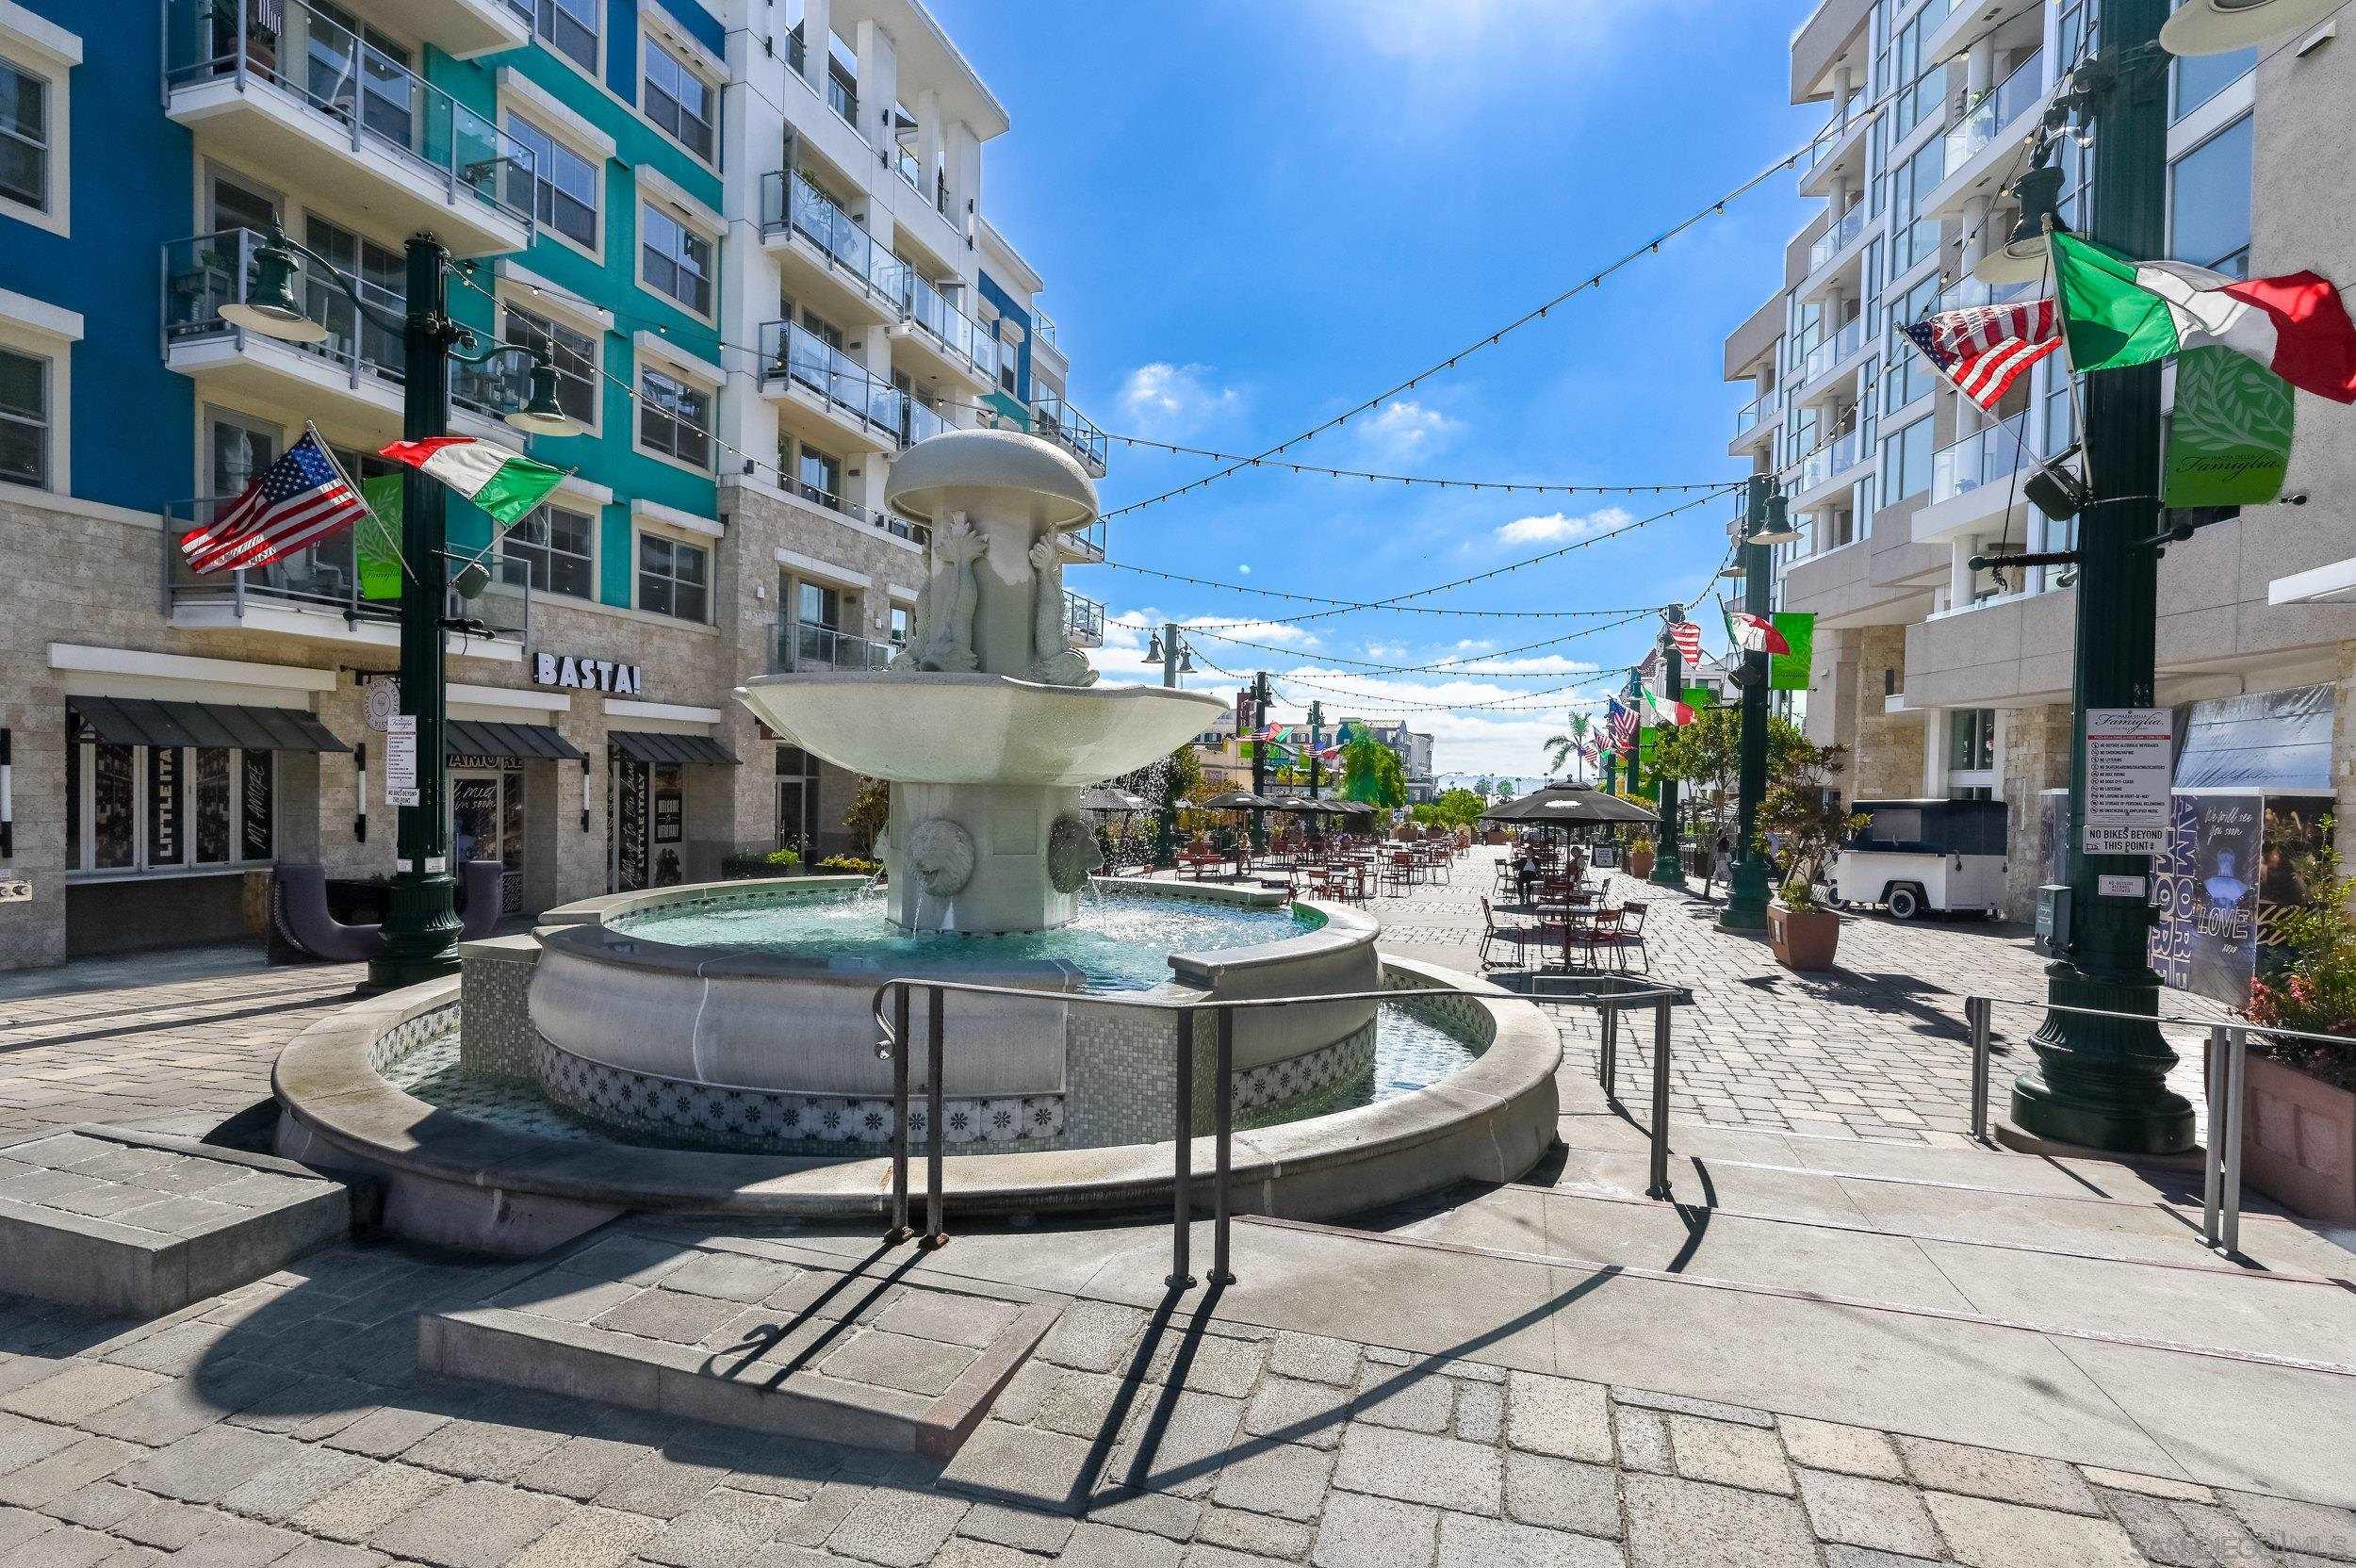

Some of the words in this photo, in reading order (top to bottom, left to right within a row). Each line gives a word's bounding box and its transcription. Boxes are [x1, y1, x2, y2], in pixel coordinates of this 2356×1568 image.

[536, 652, 641, 694] BASTA!
[159, 785, 172, 857] LITTLE
[2089, 830, 2102, 840] NO
[2103, 829, 2129, 840] BIKES
[2131, 830, 2163, 840] BEYOND
[2104, 841, 2123, 850] THIS
[2124, 841, 2148, 851] POINT
[2174, 797, 2199, 989] AMORE
[2197, 906, 2250, 939] LOVE
